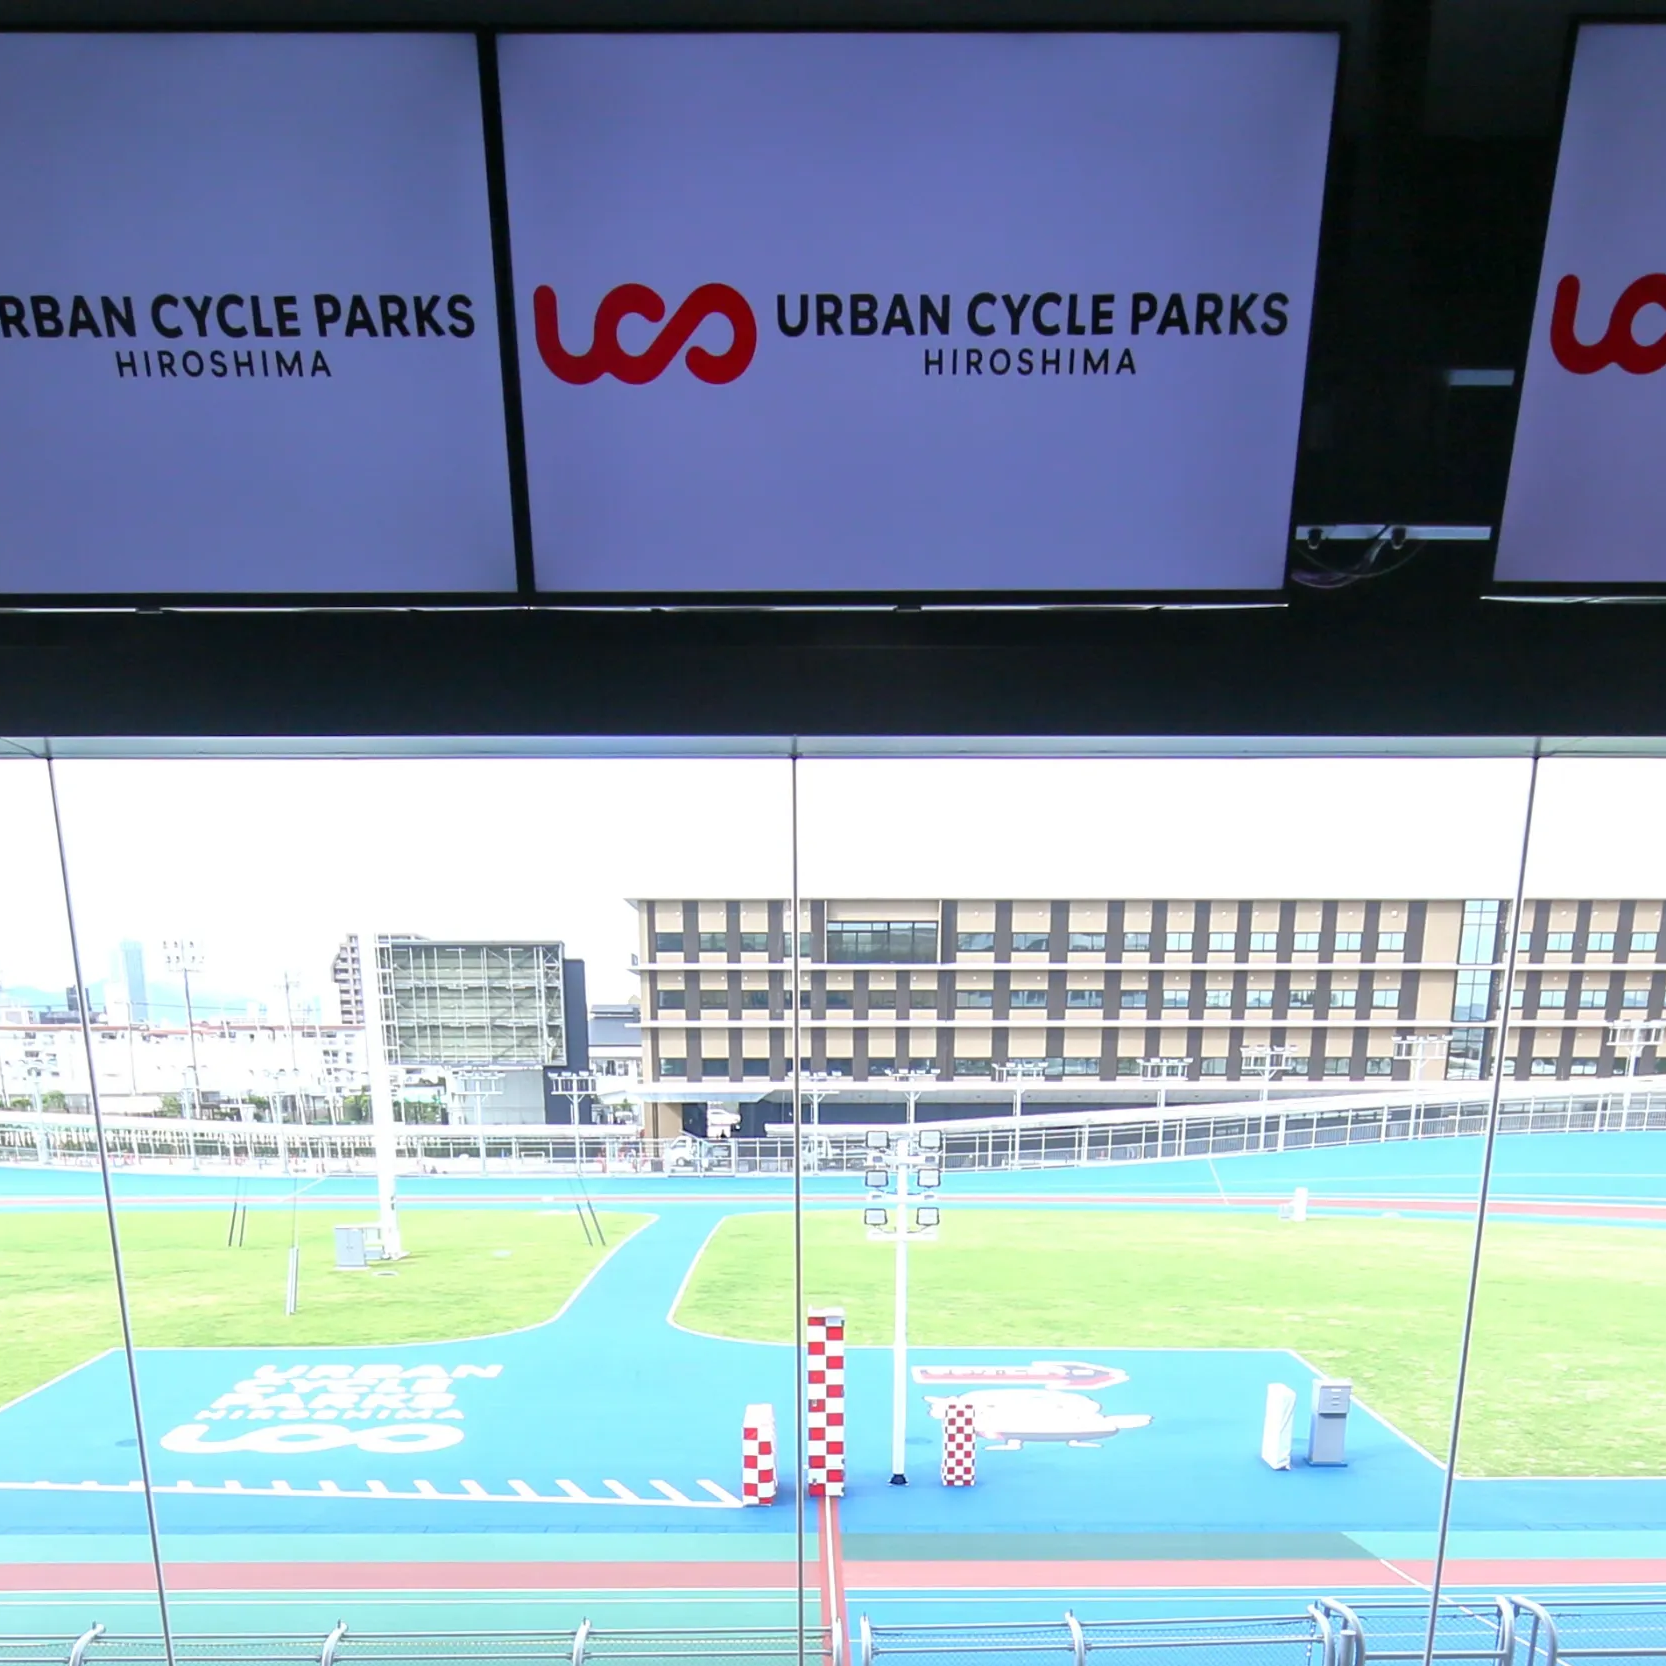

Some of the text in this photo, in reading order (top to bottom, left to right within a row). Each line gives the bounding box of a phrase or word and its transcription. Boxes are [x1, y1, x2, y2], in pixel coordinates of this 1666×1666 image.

[151, 293, 301, 339] CYCLE
[313, 293, 476, 339] PARKS
[776, 292, 1290, 338] URBAN CYCLE PARKS
[115, 350, 332, 379] HIROSHIMA
[923, 347, 1137, 376] HIROSHIMA
[253, 1364, 504, 1380] URBAN
[234, 1378, 454, 1394] CYCLE
[209, 1393, 457, 1409] PARKS
[193, 1408, 465, 1420] HIROSHIMA
